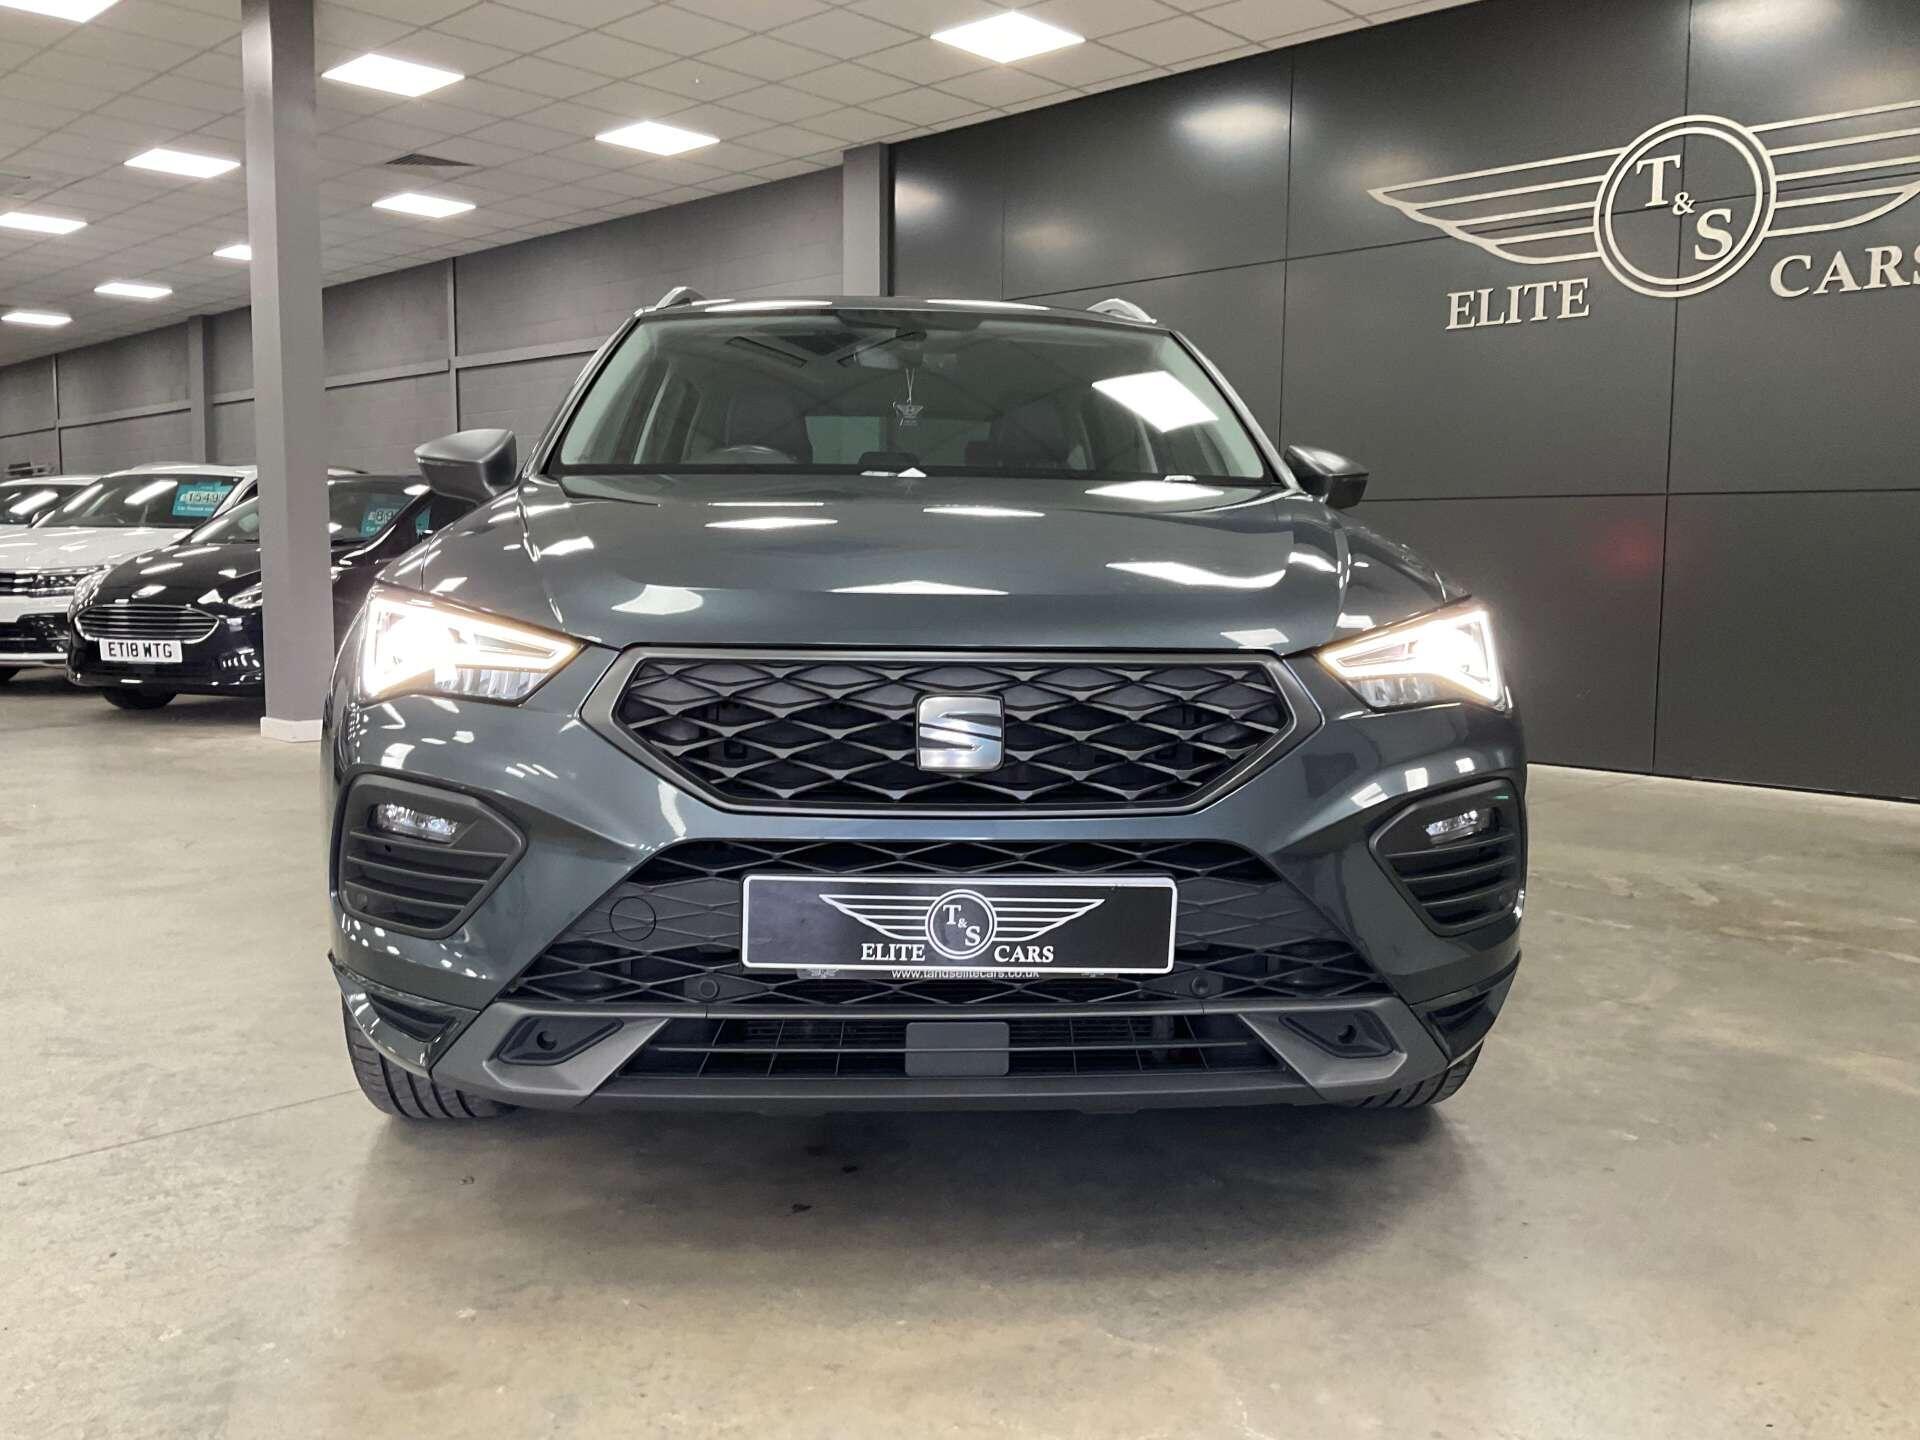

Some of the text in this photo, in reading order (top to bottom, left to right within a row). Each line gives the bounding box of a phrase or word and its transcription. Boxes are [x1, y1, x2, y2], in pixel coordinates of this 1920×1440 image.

[1446, 245, 1920, 330] ELITE CAR
[108, 642, 172, 658] ET18 WTG
[861, 943, 1054, 963] ELITE CARS
